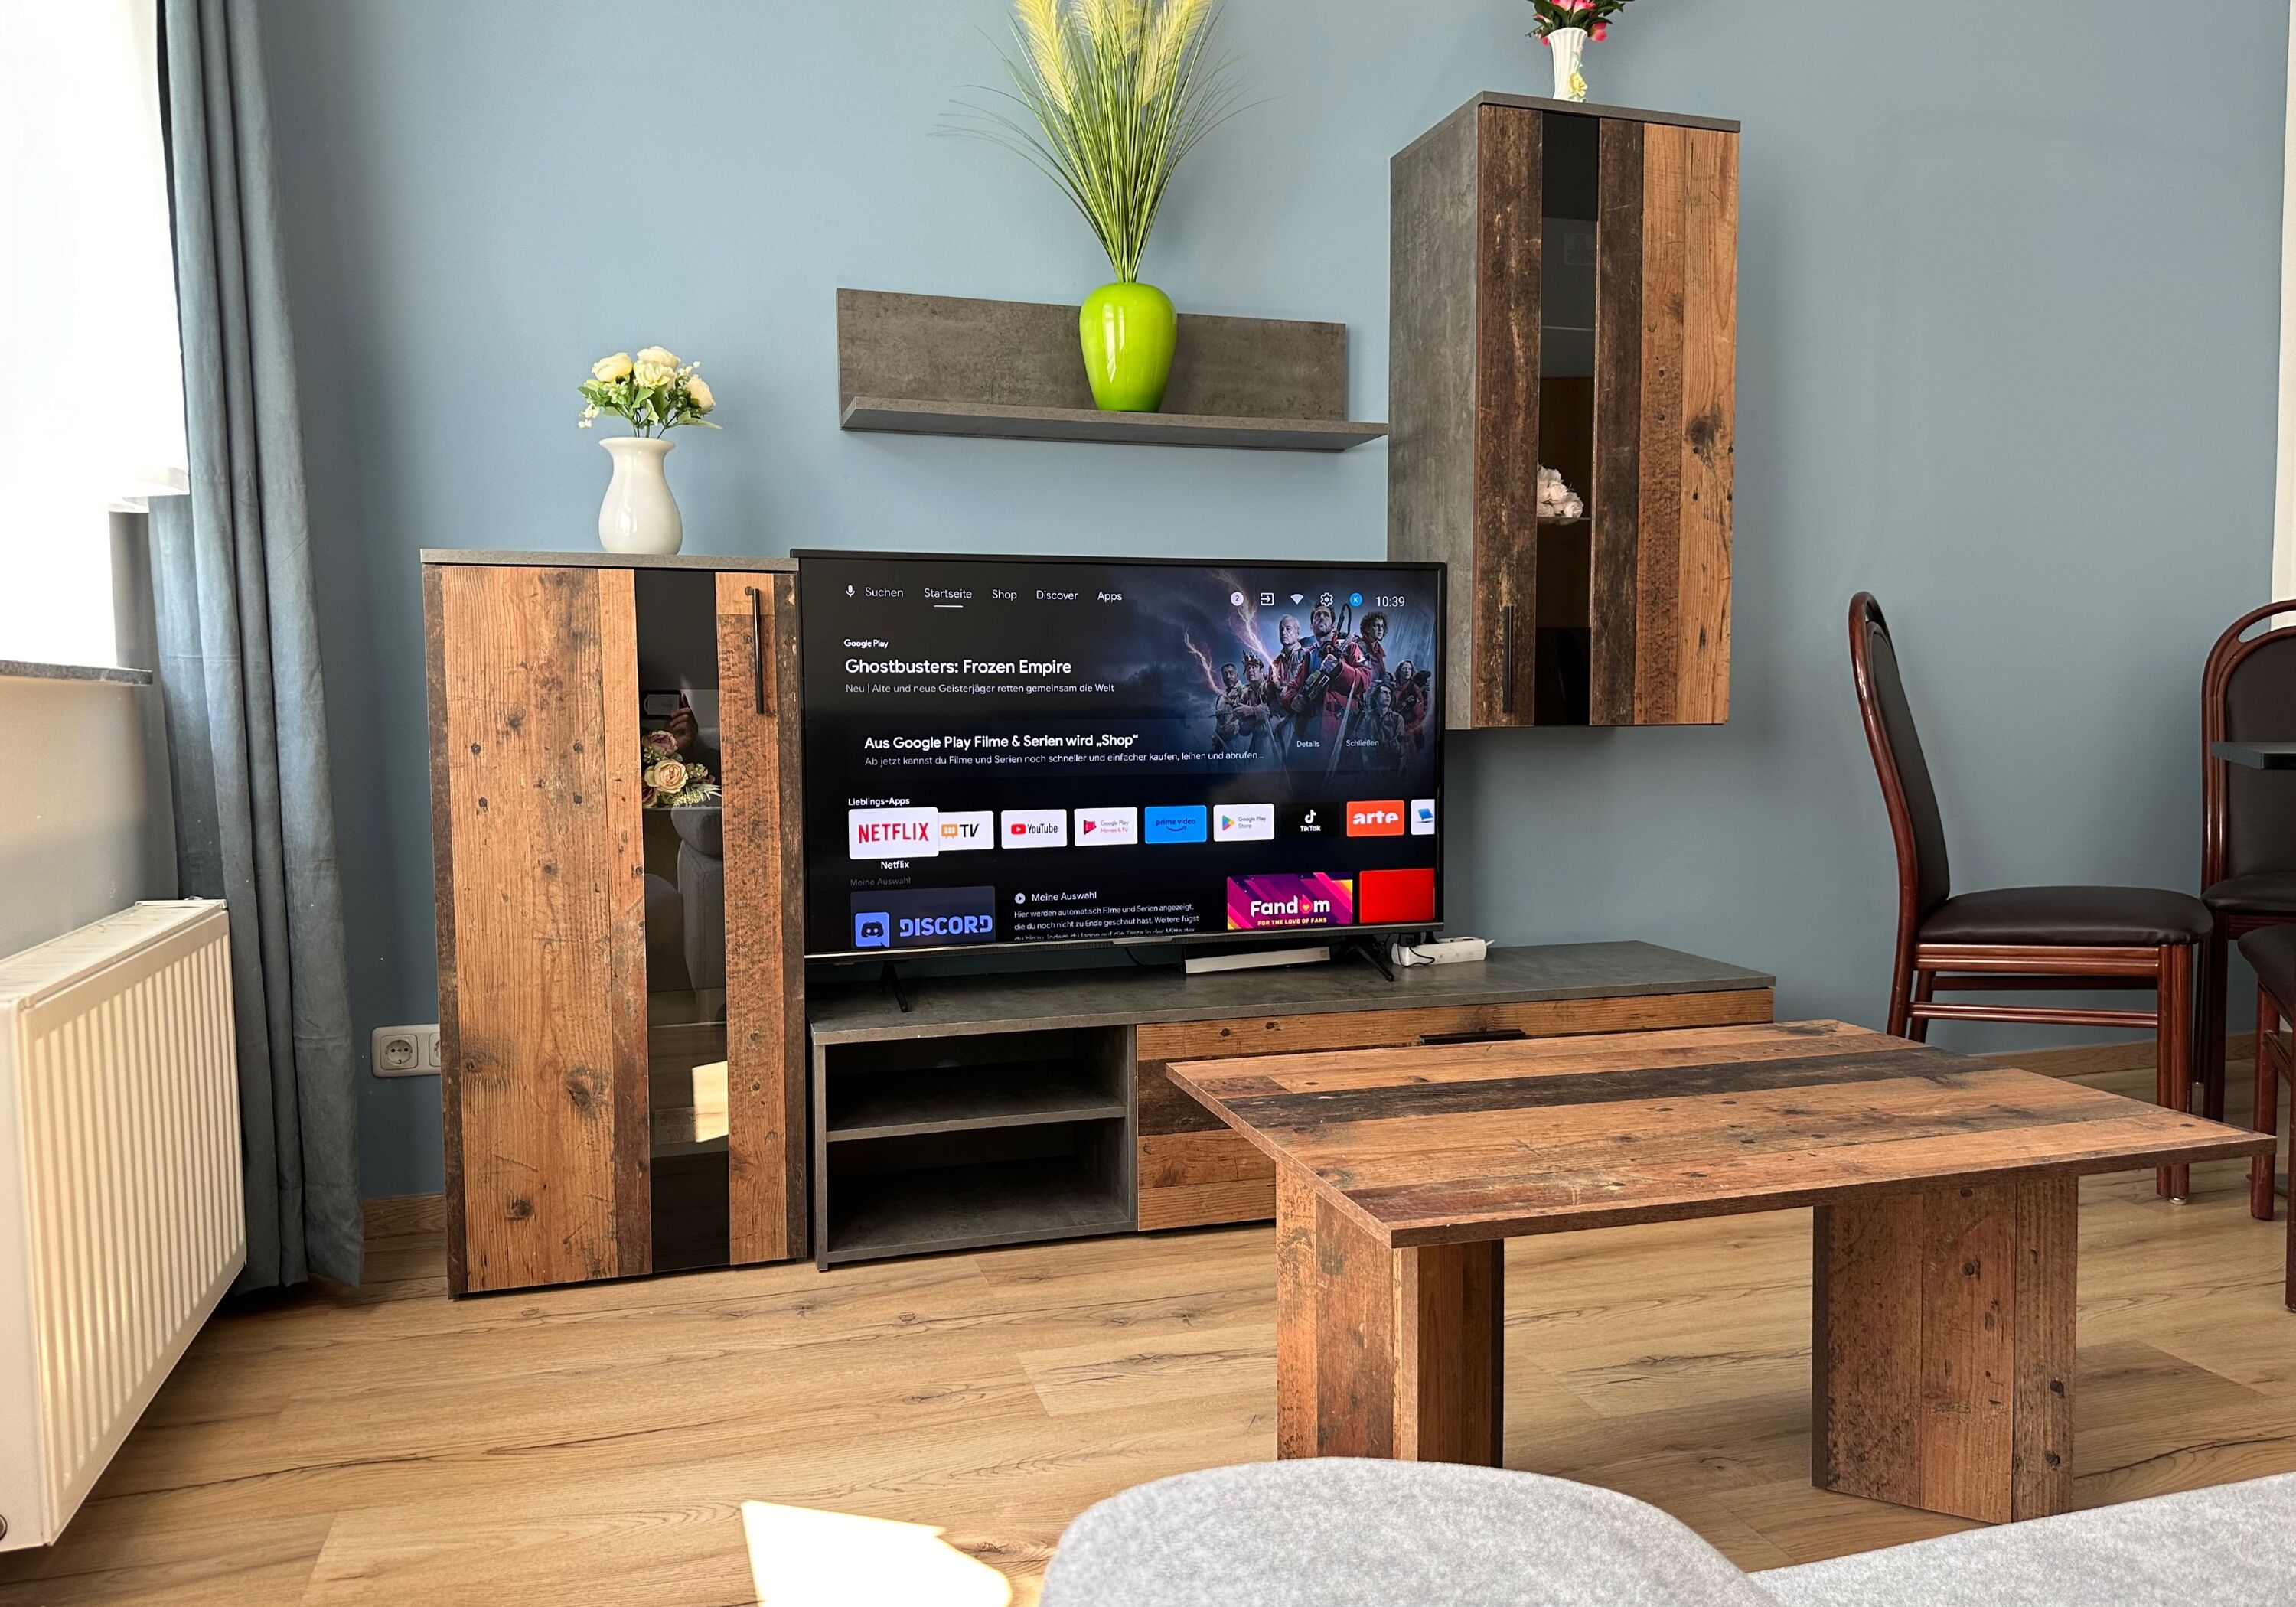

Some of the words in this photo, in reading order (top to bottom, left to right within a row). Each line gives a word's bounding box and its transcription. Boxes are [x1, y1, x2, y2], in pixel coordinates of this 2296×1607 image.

[865, 587, 904, 597] Suchen
[924, 588, 973, 598] Startseite
[992, 589, 1017, 601] Shop
[1036, 590, 1078, 600] Discover
[1097, 591, 1123, 603] Apps
[1375, 596, 1405, 607] 10:39
[843, 639, 872, 649] Google
[873, 639, 889, 649] Play
[845, 659, 958, 673] Ghostbusters:
[964, 660, 1016, 673] Frozen
[1019, 660, 1071, 677] Empire
[846, 684, 865, 693] Neu
[872, 684, 891, 693] Alte
[894, 684, 911, 693] und
[938, 683, 995, 695] Geisterjäger
[997, 684, 1024, 693] retten
[1026, 683, 1077, 695] gemeinsam
[1079, 683, 1093, 693] die
[1095, 683, 1115, 693] Welt
[864, 737, 890, 749] Aus
[893, 736, 941, 751] Google
[944, 736, 971, 751] Play
[974, 735, 1009, 748] Filme
[1011, 735, 1020, 747] &
[1023, 735, 1063, 747] Serien
[1065, 735, 1093, 746] wird
[865, 757, 878, 766] Ab
[880, 757, 901, 768] jetzt
[903, 756, 932, 765] kannst
[934, 756, 947, 764] du
[949, 755, 973, 764] Filme
[975, 755, 992, 764] und
[995, 755, 1022, 764] Serien
[1024, 755, 1046, 763] noch
[1049, 754, 1087, 763] schneller
[1089, 754, 1105, 762] und
[1107, 753, 1147, 761] einfacher
[1149, 752, 1179, 761] kaufen,
[1182, 752, 1206, 761] leihen
[1225, 751, 1257, 760] abrufen
[848, 797, 910, 807] Lieblings-Apps
[1156, 818, 1176, 826] prime
[1352, 810, 1399, 825] arte
[858, 823, 929, 843] NETFLIX
[959, 823, 980, 838] TV
[1028, 823, 1058, 833] YouTube
[881, 860, 910, 869] Netflix
[877, 877, 911, 885] Auswahl
[1031, 893, 1058, 901] Meine
[1060, 891, 1097, 901] Auswahl
[1058, 908, 1101, 916] automatisch
[899, 914, 993, 937] DISCORD
[1104, 918, 1135, 927] geschaut
[1182, 915, 1199, 924] fügst
